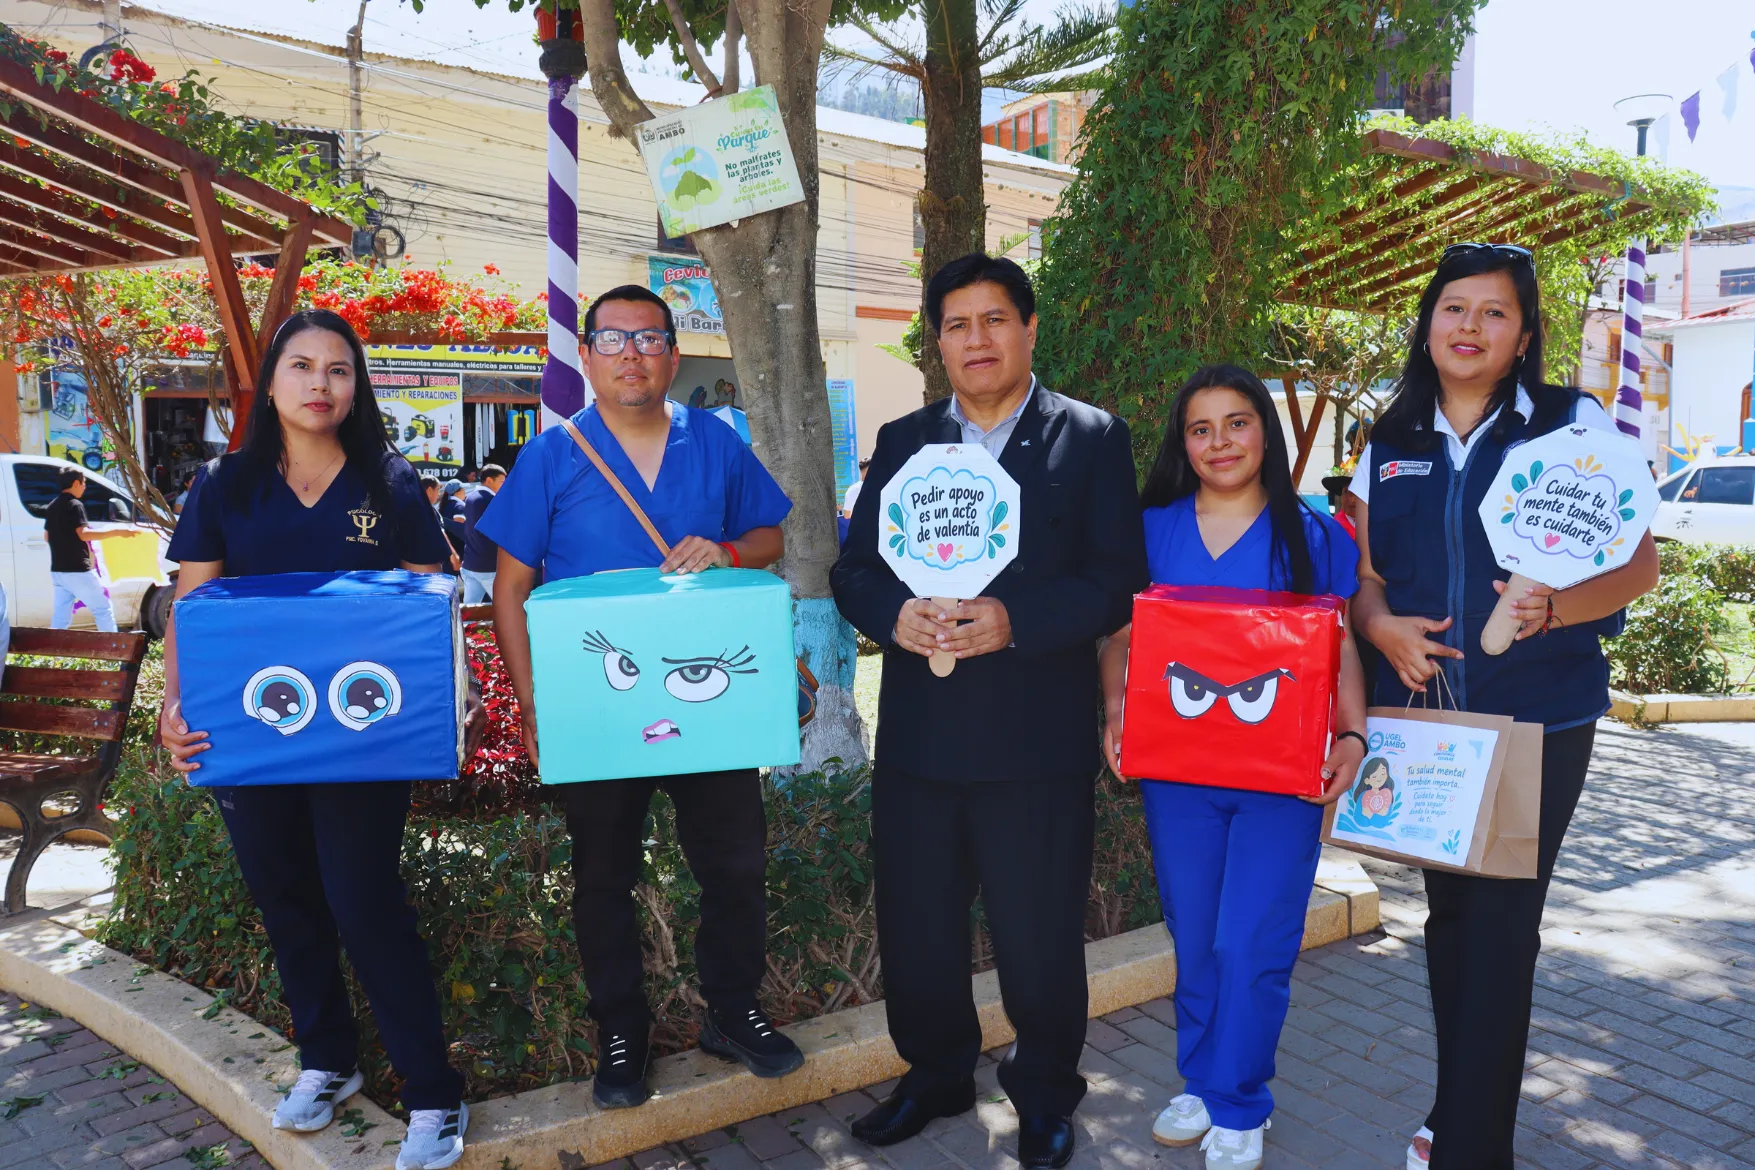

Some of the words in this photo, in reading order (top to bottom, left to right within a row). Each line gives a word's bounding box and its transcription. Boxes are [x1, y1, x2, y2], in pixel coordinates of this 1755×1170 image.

[659, 127, 686, 141] AMBO
[717, 129, 771, 151] Parque
[724, 162, 738, 171] No
[740, 150, 782, 168] maltrates
[727, 170, 741, 179] las
[742, 160, 774, 176] plantas
[776, 158, 782, 166] y
[768, 177, 782, 186] las
[690, 316, 725, 331] Bar
[386, 359, 431, 367] Herramientas
[466, 361, 498, 370] eléctricos
[513, 363, 536, 371] talleres
[422, 374, 429, 387] Y
[429, 375, 459, 387] EQUIPOS
[401, 390, 406, 399] Y
[408, 390, 458, 400] REPARACIONES
[911, 485, 945, 509] Pedir
[948, 487, 984, 506] apoyo
[1545, 479, 1591, 502] Cuidar
[1591, 491, 1607, 510] tu
[919, 510, 931, 524] es
[934, 506, 949, 519] un
[952, 504, 977, 519] acto
[1523, 497, 1565, 514] mente
[1566, 501, 1613, 536] también
[917, 525, 931, 543] de
[934, 519, 980, 538] valentía
[1525, 514, 1540, 526] es
[1543, 517, 1596, 546] cuidarte
[1383, 740, 1406, 749] AMBO
[1385, 732, 1402, 742] UGEL
[1407, 765, 1415, 776] Tu
[1416, 764, 1435, 775] salud
[1436, 766, 1466, 779] mental
[1432, 779, 1460, 790] importa.
[1435, 791, 1447, 803] hoy
